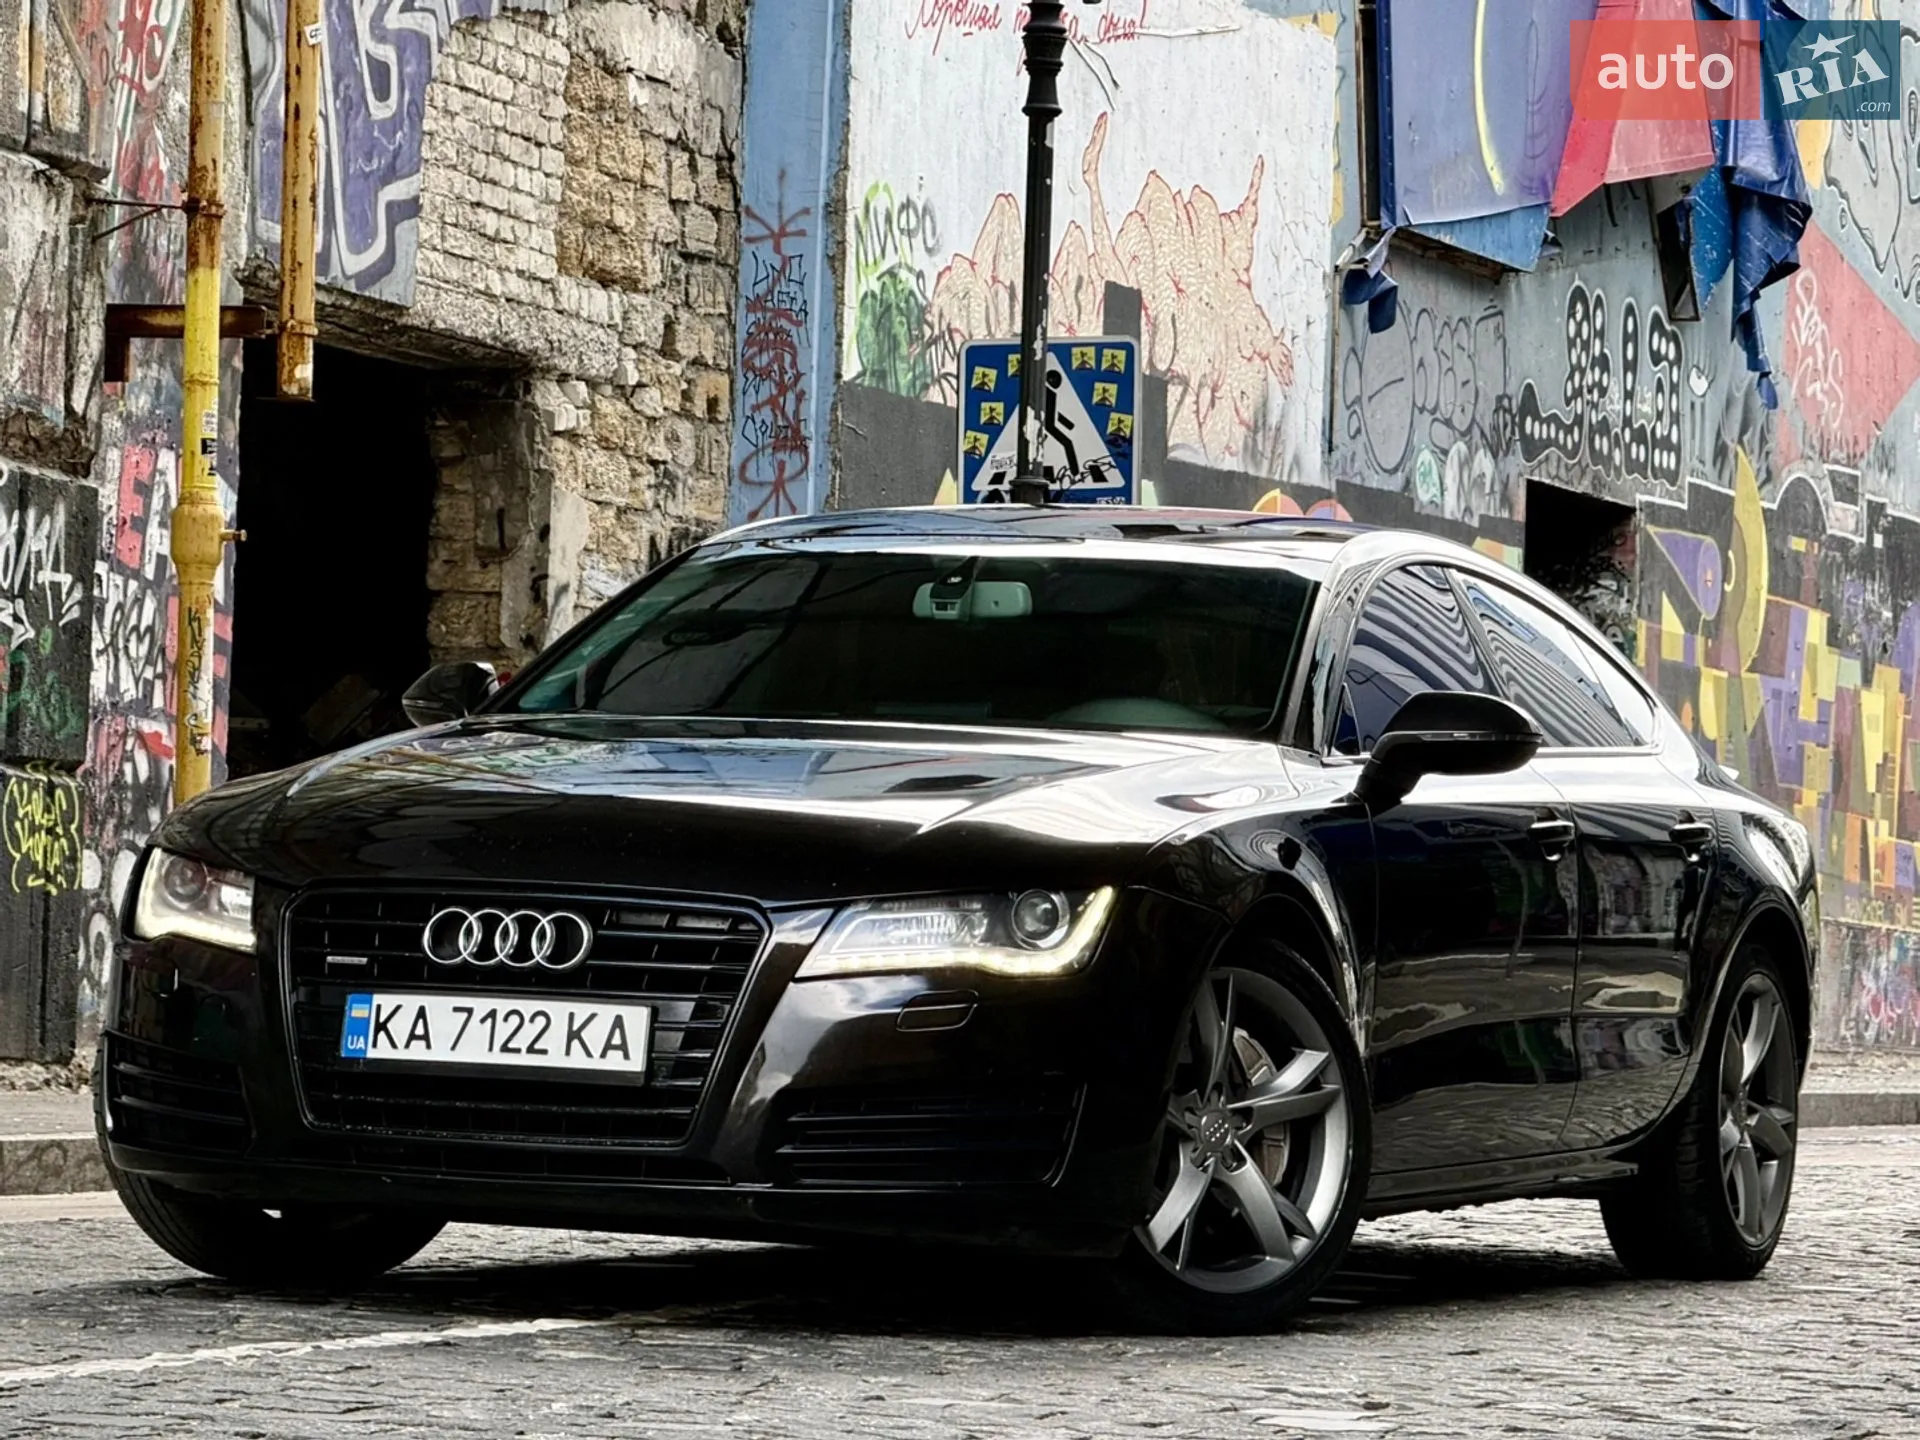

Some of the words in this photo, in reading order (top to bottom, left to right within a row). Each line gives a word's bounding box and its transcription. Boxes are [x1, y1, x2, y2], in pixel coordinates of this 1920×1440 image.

[347, 1034, 365, 1050] UA
[372, 1003, 432, 1050] KA
[450, 1006, 552, 1054] 7122
[564, 1011, 631, 1061] KA
